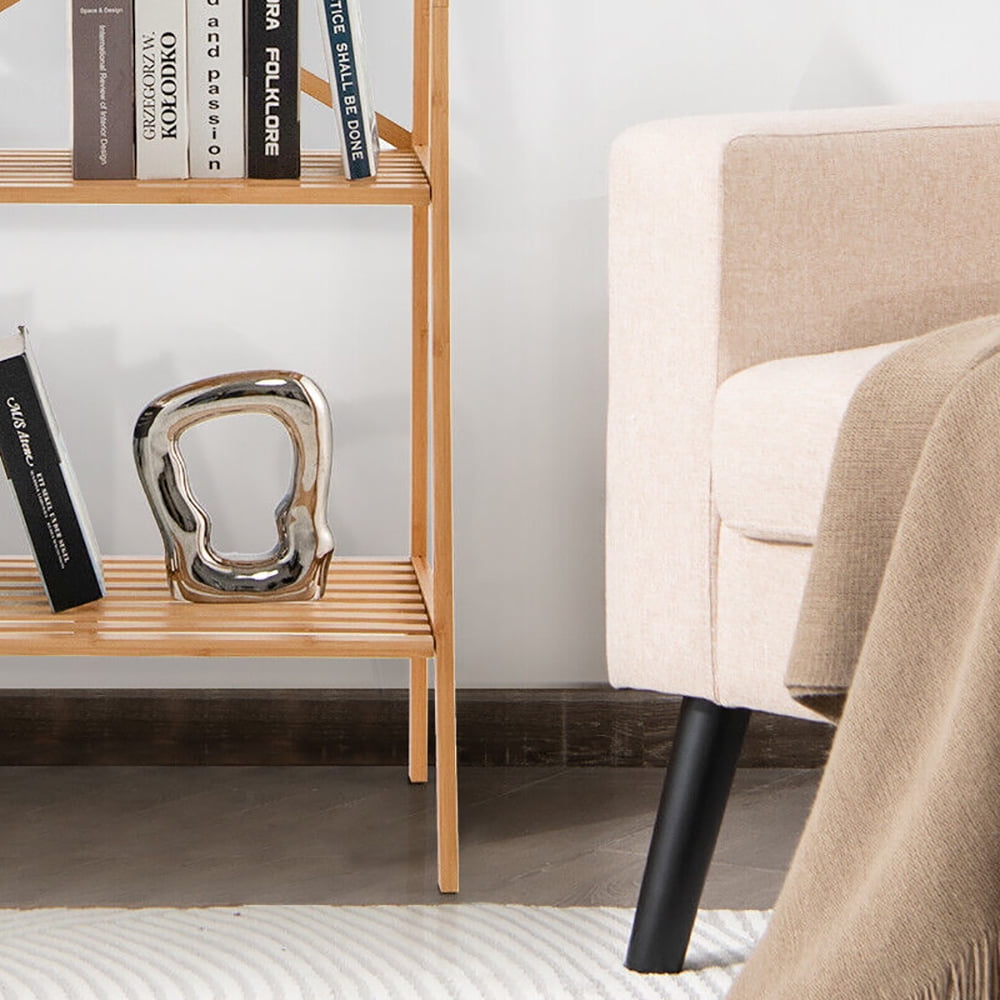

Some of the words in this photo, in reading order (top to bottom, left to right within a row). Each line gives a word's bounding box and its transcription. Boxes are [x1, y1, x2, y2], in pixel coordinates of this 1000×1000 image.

[104, 6, 124, 15] Design
[99, 25, 107, 72] International
[208, 17, 219, 57] and
[99, 72, 108, 100] Review
[159, 31, 177, 140] KOŁODKO
[336, 42, 356, 92] SHALL
[100, 101, 108, 110] of
[142, 53, 156, 141] GRZEGORZ
[264, 48, 280, 157] FOLKLORE
[342, 96, 357, 116] BE
[100, 110, 109, 137] Interior
[208, 69, 221, 171] passion
[346, 119, 364, 161] DONE
[99, 138, 109, 165] Design
